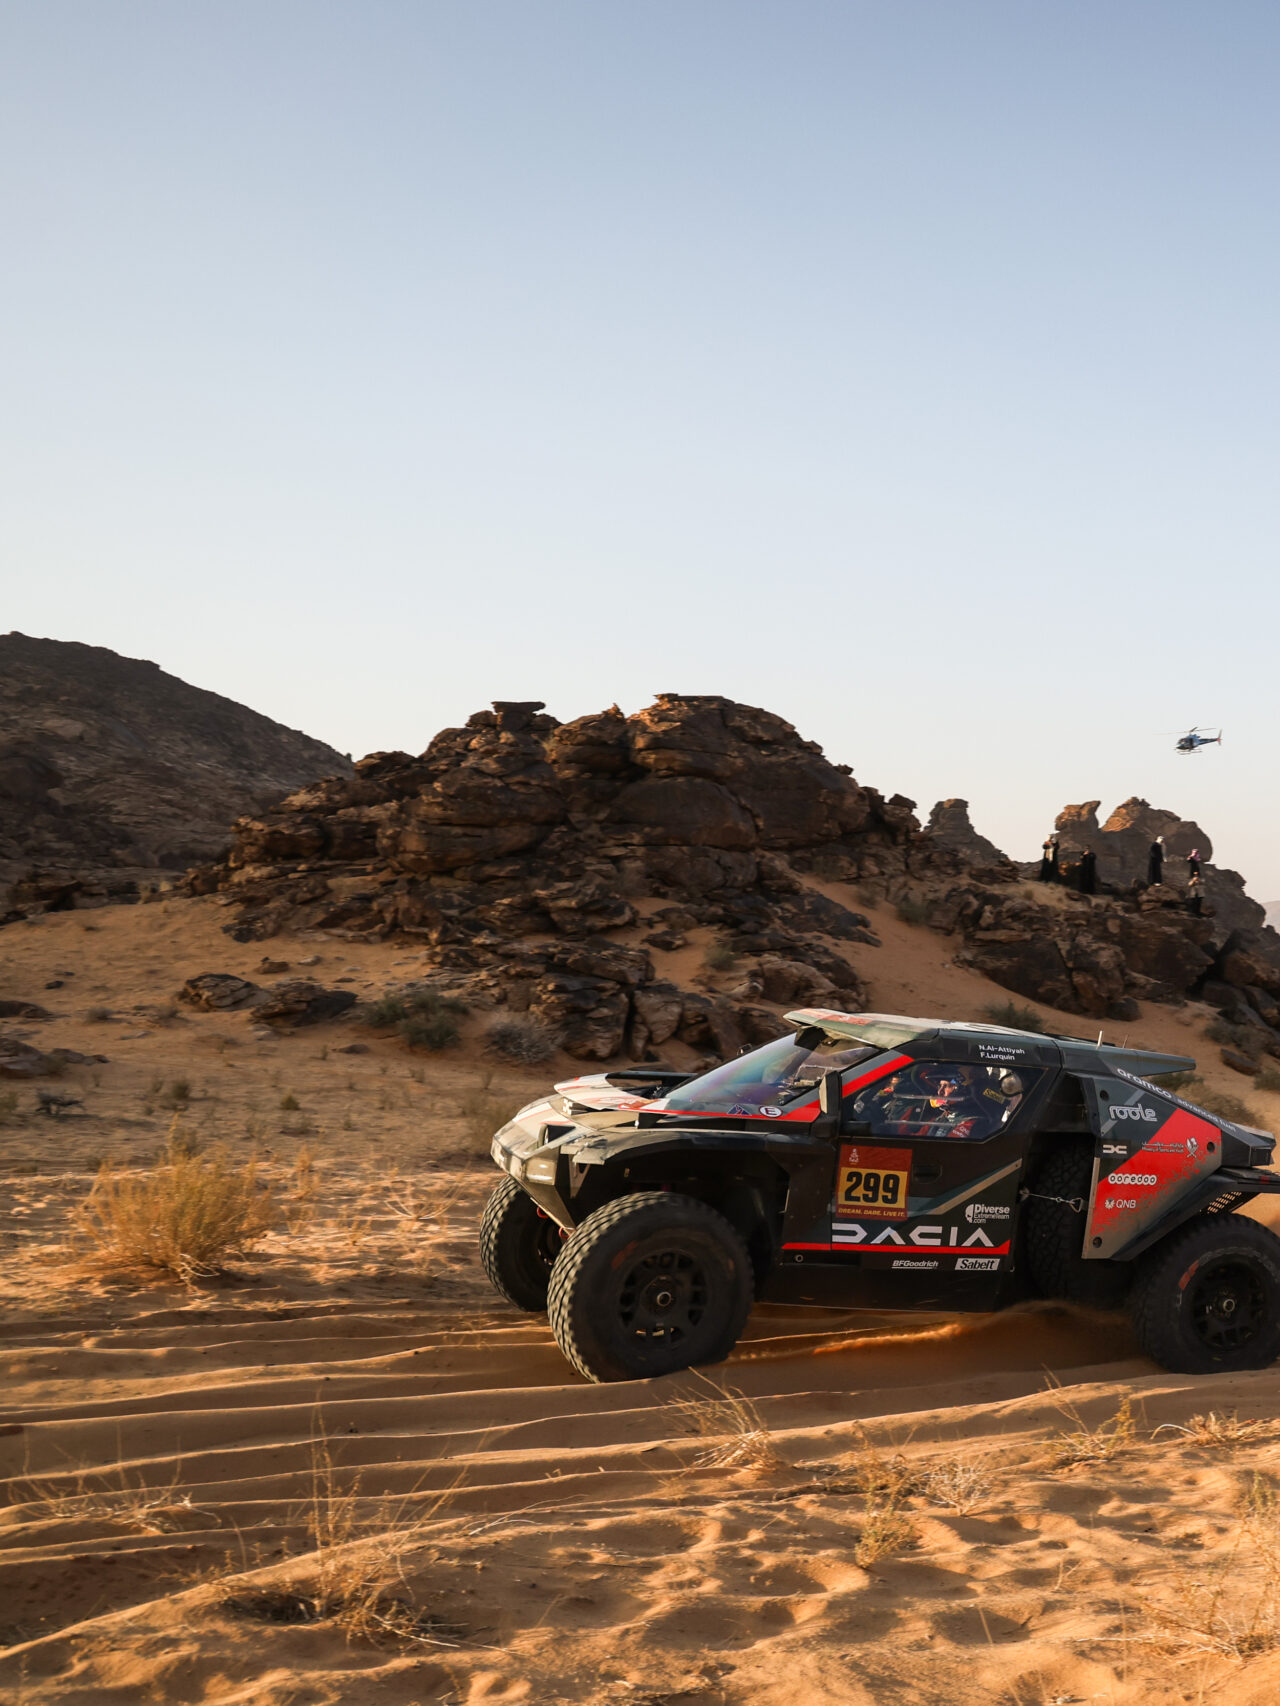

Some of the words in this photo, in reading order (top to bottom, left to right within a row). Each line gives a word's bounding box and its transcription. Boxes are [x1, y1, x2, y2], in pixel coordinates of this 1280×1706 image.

[1117, 1068, 1172, 1099] aramco
[1109, 1174, 1157, 1185] ooredoo
[844, 1171, 900, 1204] 299
[974, 1204, 1010, 1214] Diverse
[1115, 1200, 1136, 1209] QNB
[831, 1223, 994, 1247] DACIA
[892, 1260, 939, 1268] BFGoodrich
[960, 1259, 995, 1270] Sabelt
